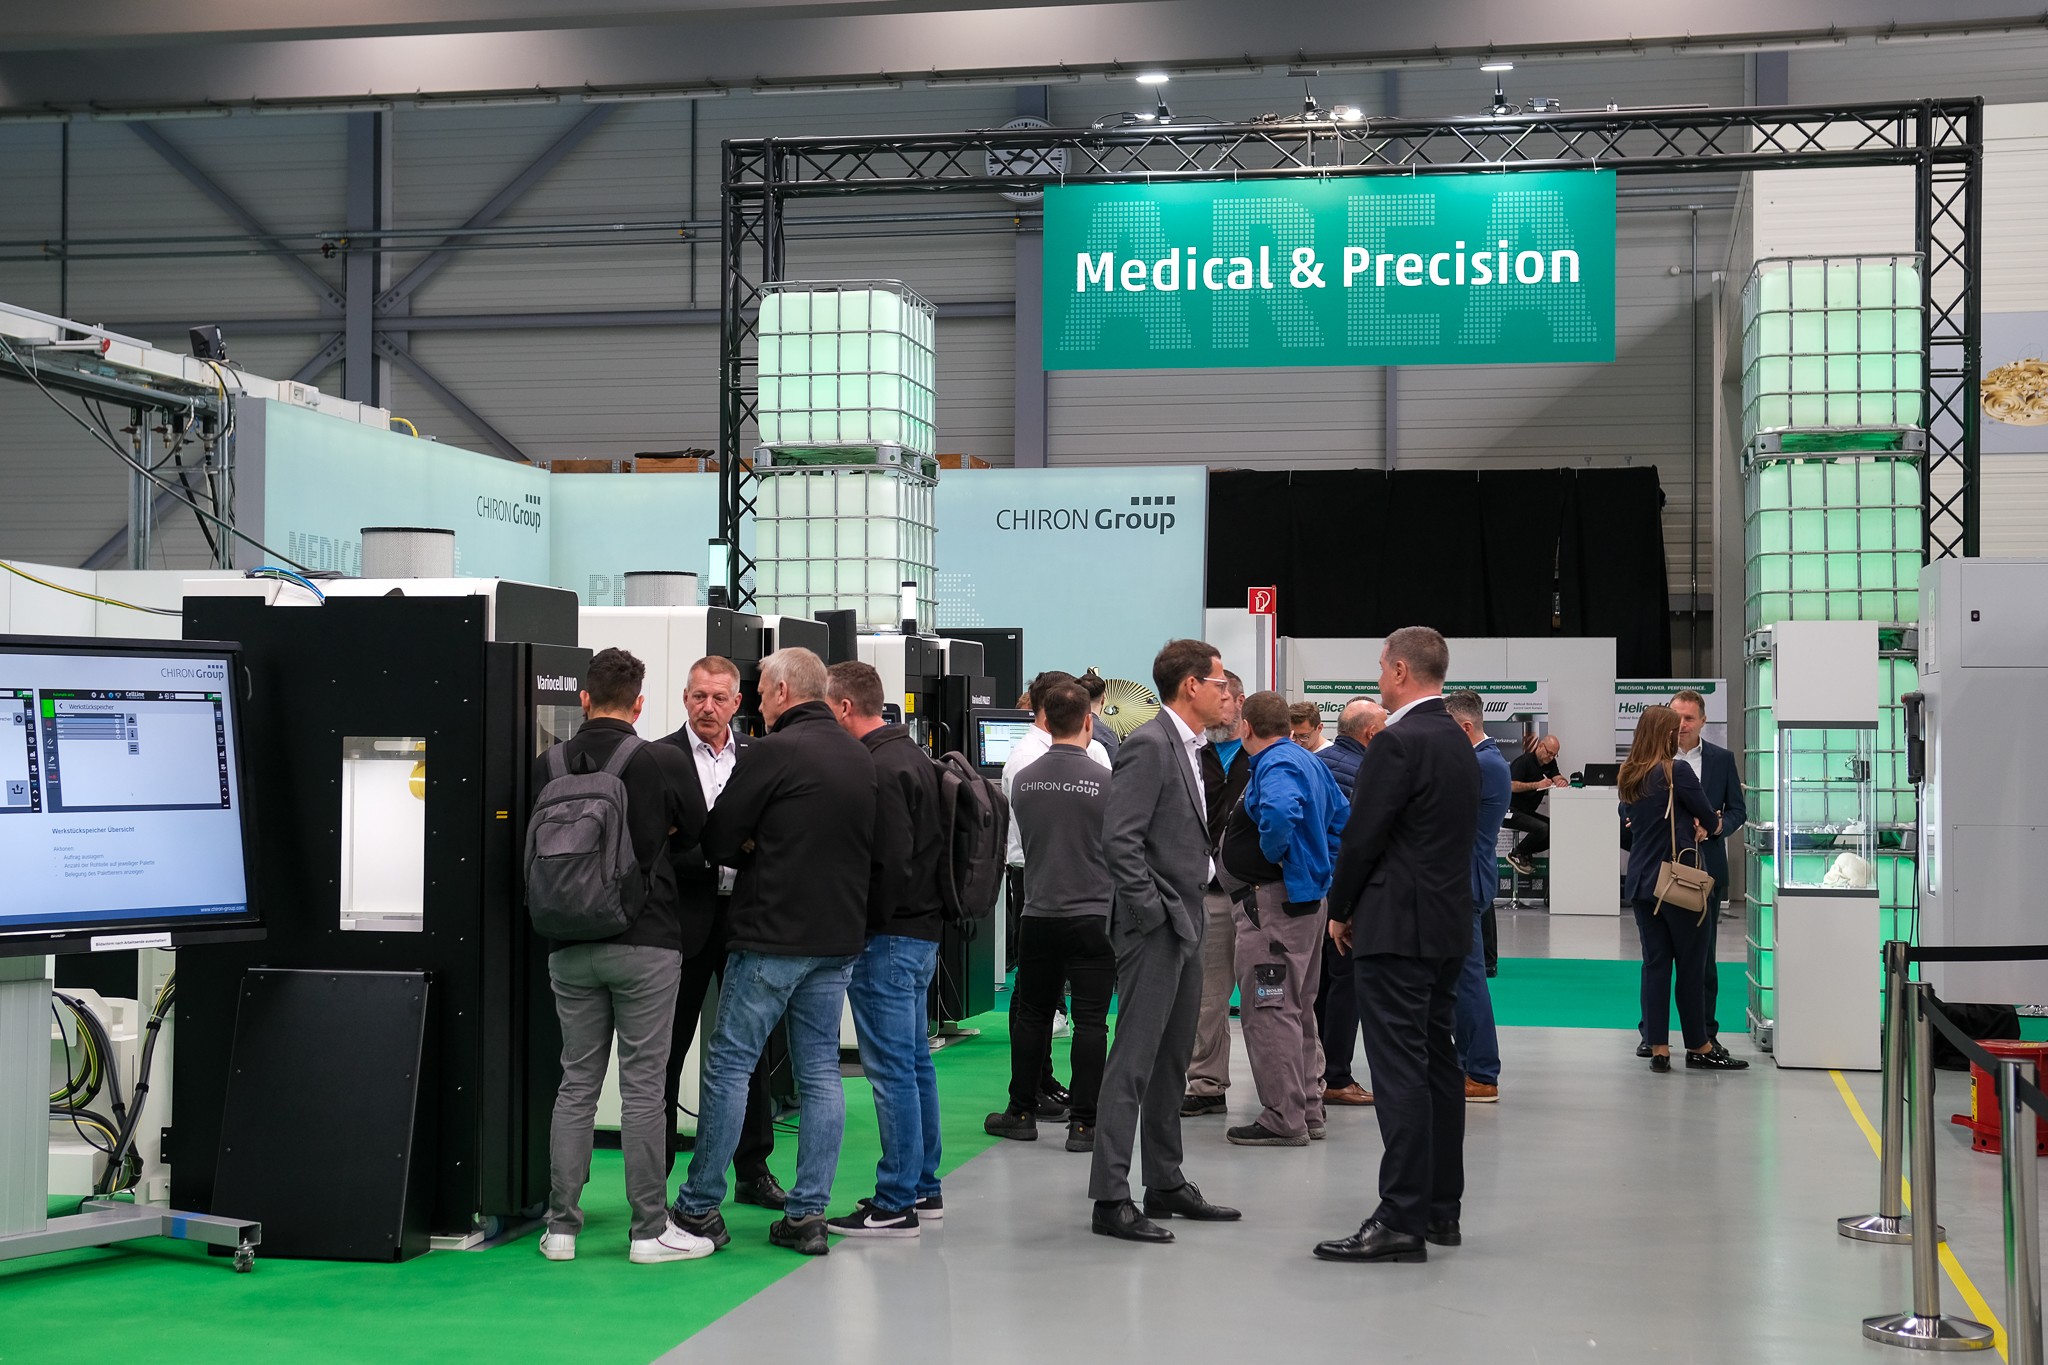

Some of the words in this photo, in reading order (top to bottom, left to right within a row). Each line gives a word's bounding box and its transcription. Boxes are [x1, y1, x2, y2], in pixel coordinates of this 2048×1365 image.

[1077, 245, 1274, 293] Medical
[1289, 247, 1326, 289] &
[1343, 240, 1580, 287] Precision
[476, 496, 512, 523] CHIRON
[512, 504, 541, 533] Group
[996, 508, 1089, 530] CHIRON
[1094, 508, 1176, 535] Group
[289, 531, 362, 577] MEDICA
[160, 667, 195, 678] CHIRON
[195, 669, 225, 681] Group
[536, 674, 564, 691] Variocell
[564, 676, 578, 692] UNO
[1315, 701, 1346, 713] elica
[1020, 782, 1061, 792] CHIRON
[1062, 783, 1099, 796] Group
[52, 827, 106, 835] Werkstückspeicher
